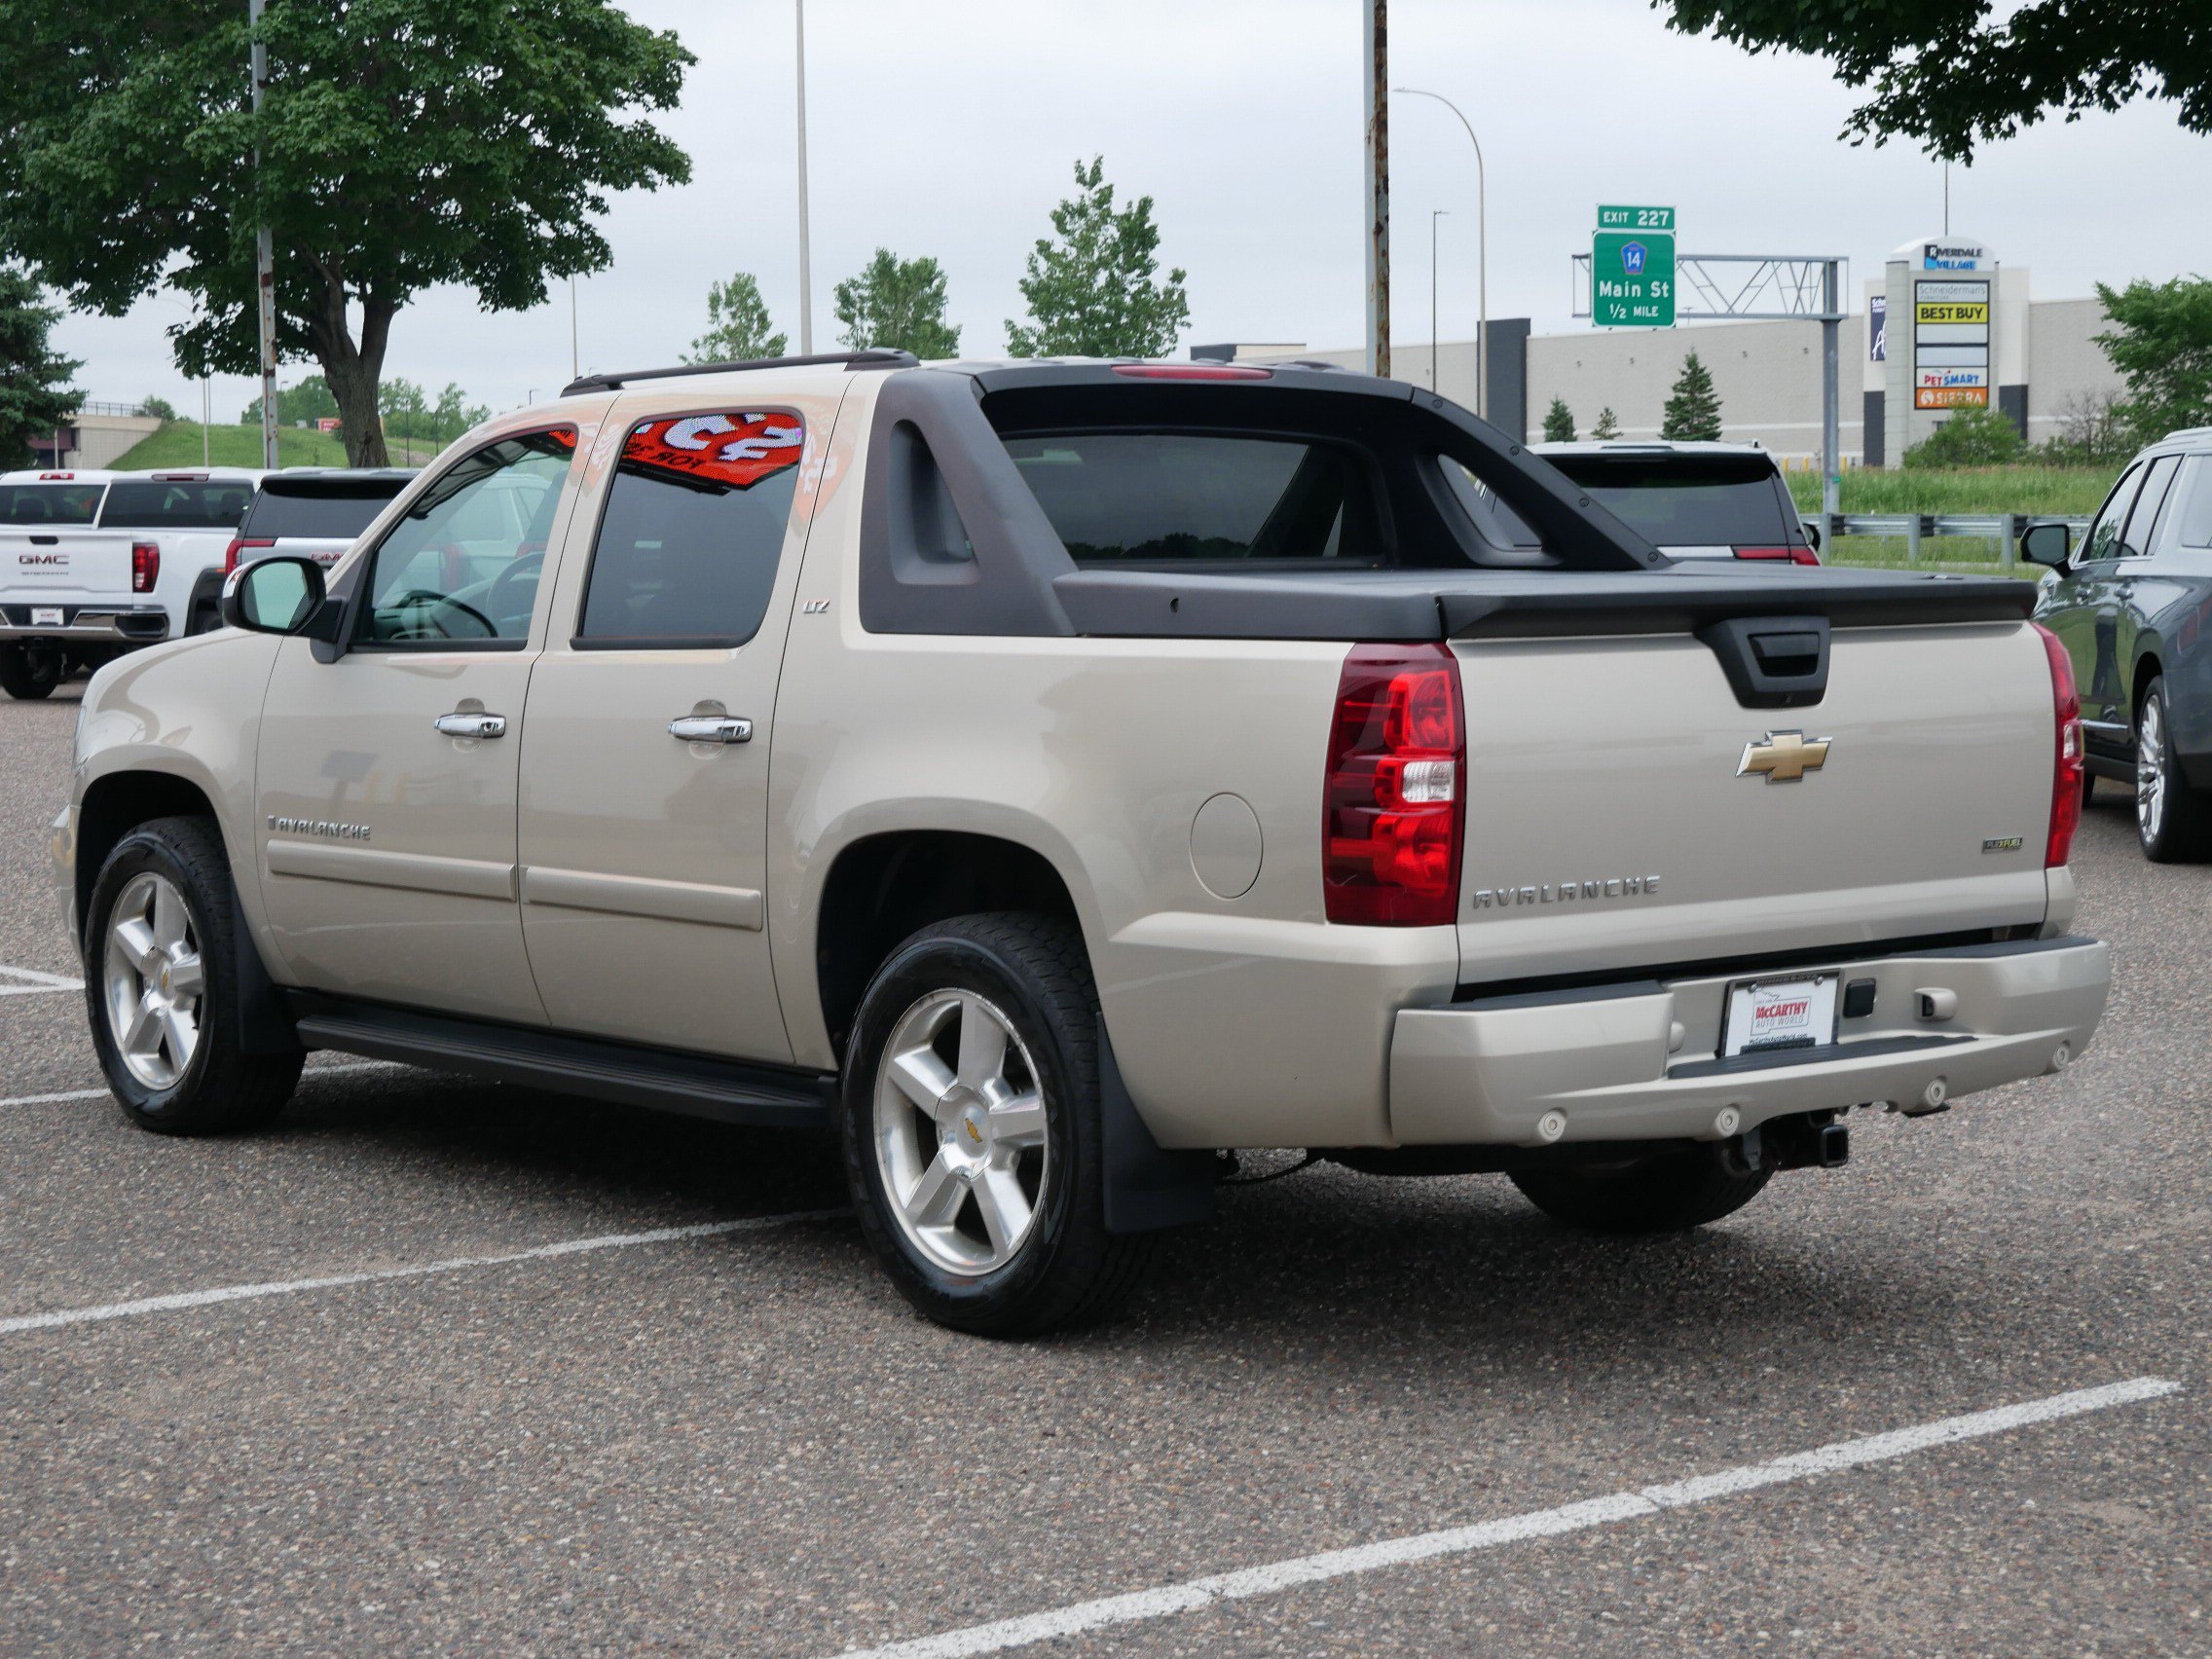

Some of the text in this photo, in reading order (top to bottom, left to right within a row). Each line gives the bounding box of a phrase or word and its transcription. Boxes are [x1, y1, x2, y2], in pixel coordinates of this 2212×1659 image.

[1604, 210, 1669, 226] EXIT 227
[1627, 251, 1641, 267] 14
[1930, 246, 1982, 258] RIVERDALE
[1599, 280, 1670, 298] Main St
[1633, 306, 1659, 317] MILE
[1921, 307, 1983, 319] BEST BUY
[18, 555, 69, 565] GMC
[803, 600, 830, 614] LTZ
[278, 818, 371, 841] AVALANCHE
[1473, 875, 1660, 909] AVALANCHE
[1755, 1001, 1808, 1020] McCARTHY
[1755, 1015, 1804, 1028] AUTO WORLD
